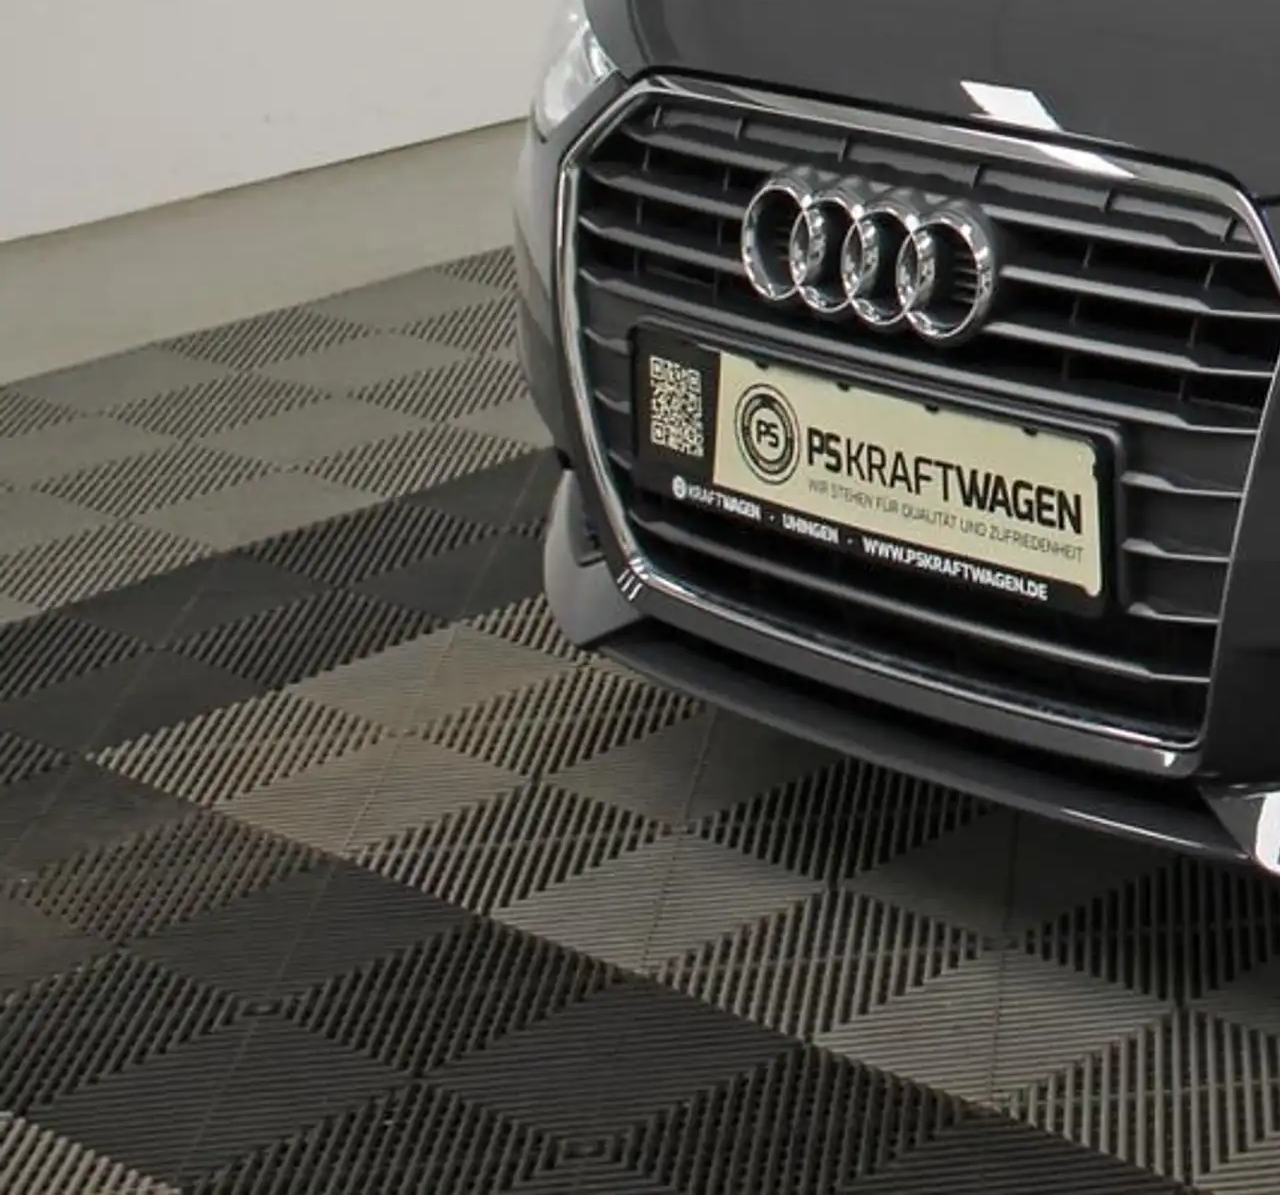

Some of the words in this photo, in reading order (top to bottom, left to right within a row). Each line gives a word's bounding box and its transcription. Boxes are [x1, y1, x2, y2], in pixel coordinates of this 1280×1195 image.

[756, 418, 779, 449] PS
[809, 479, 828, 495] WIR
[830, 483, 873, 509] STEHEN
[960, 517, 988, 537] UND
[989, 524, 1084, 563] ZUFRIEDENHEIT
[862, 535, 1049, 602] WWW.PSKRAFTWAGEN.DE
